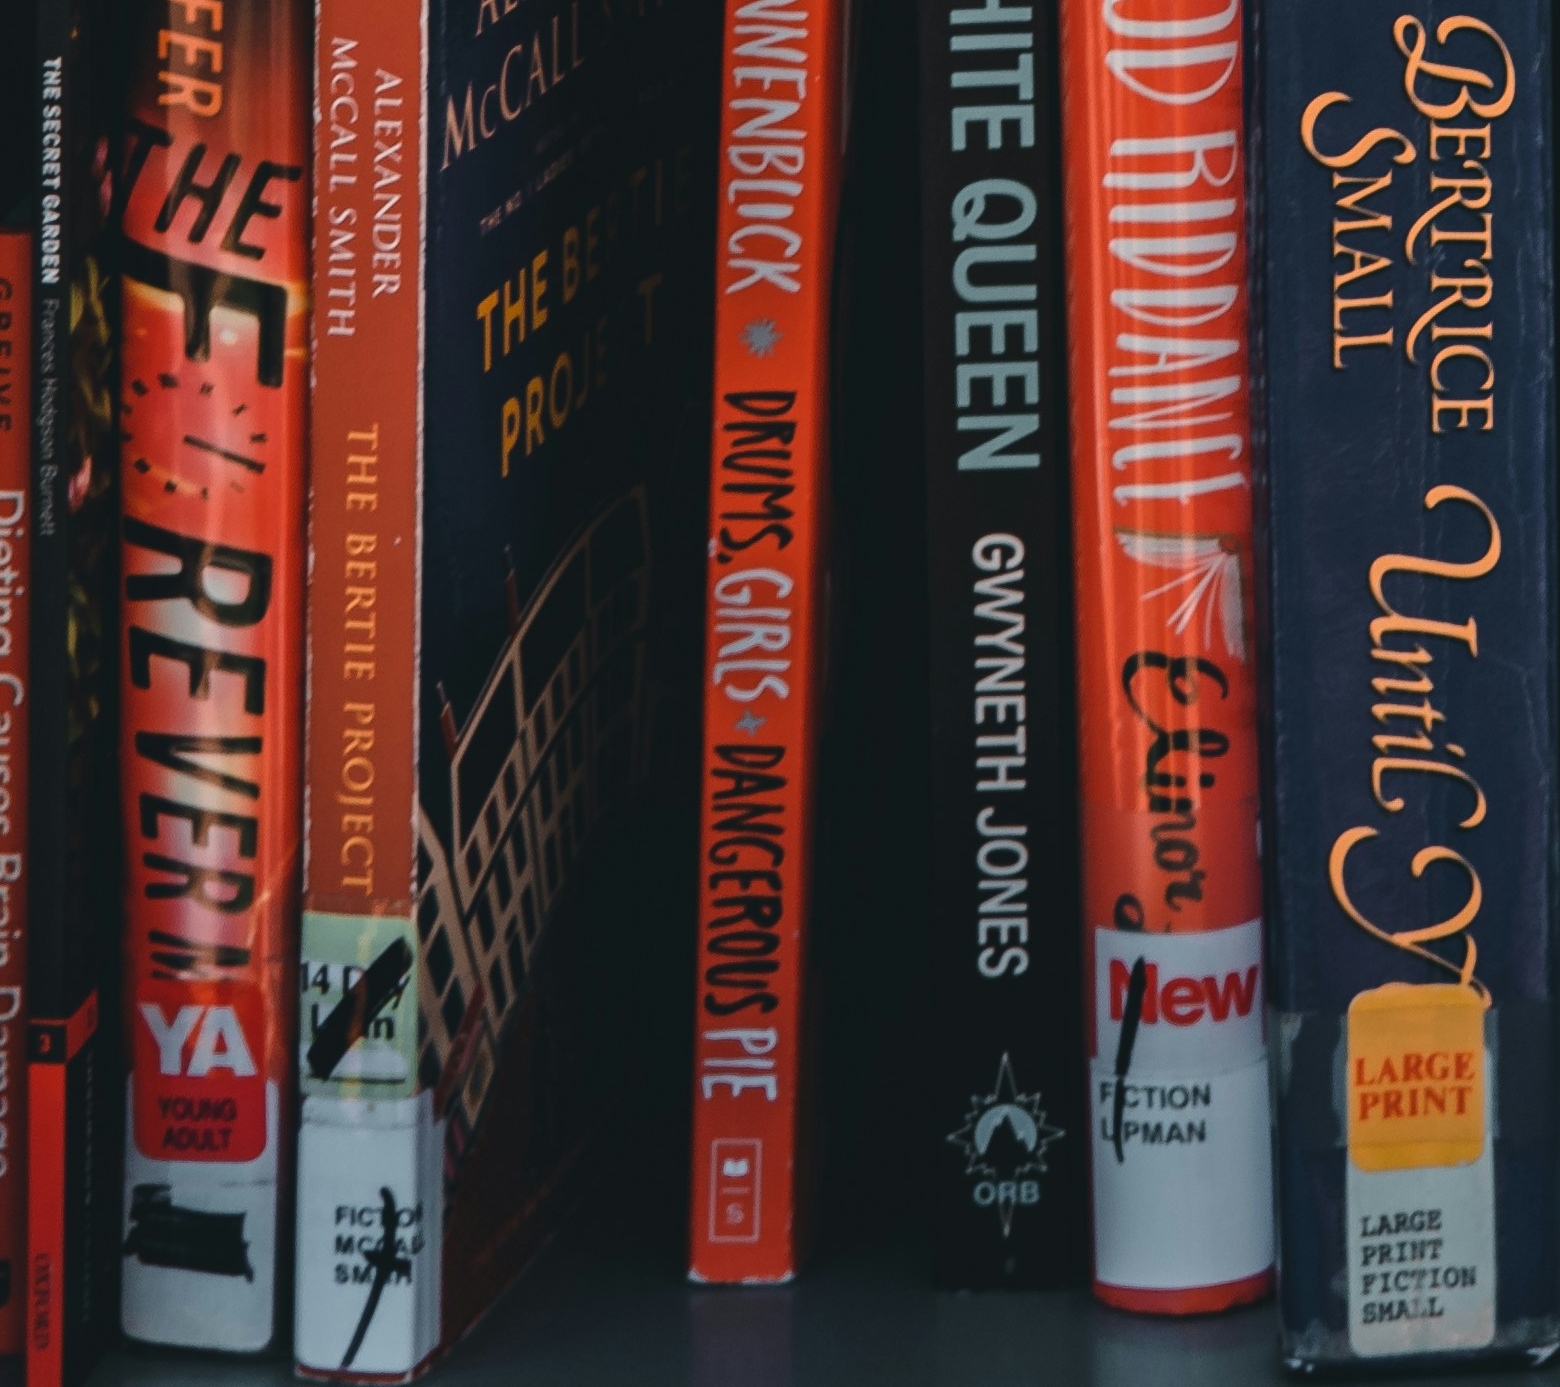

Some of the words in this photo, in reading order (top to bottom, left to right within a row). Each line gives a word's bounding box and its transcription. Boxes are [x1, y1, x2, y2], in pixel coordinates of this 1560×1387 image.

[41, 56, 62, 95] THE
[41, 99, 62, 183] SECRET
[42, 186, 61, 286] GARDEN
[950, 179, 1039, 473] QUEEN
[718, 389, 800, 564] DRUMS,
[712, 568, 793, 702] GIRLS
[971, 534, 1026, 793] GWYNETH
[706, 743, 786, 1021] DANGEROUS
[975, 810, 1028, 979] JONES
[138, 1004, 253, 1077] YA
[702, 1027, 778, 1103] PIE
[1354, 1052, 1474, 1085] LARGE
[158, 1099, 236, 1121] YOUNG
[162, 1126, 232, 1151] ADULT
[1356, 1086, 1474, 1122] PRINT
